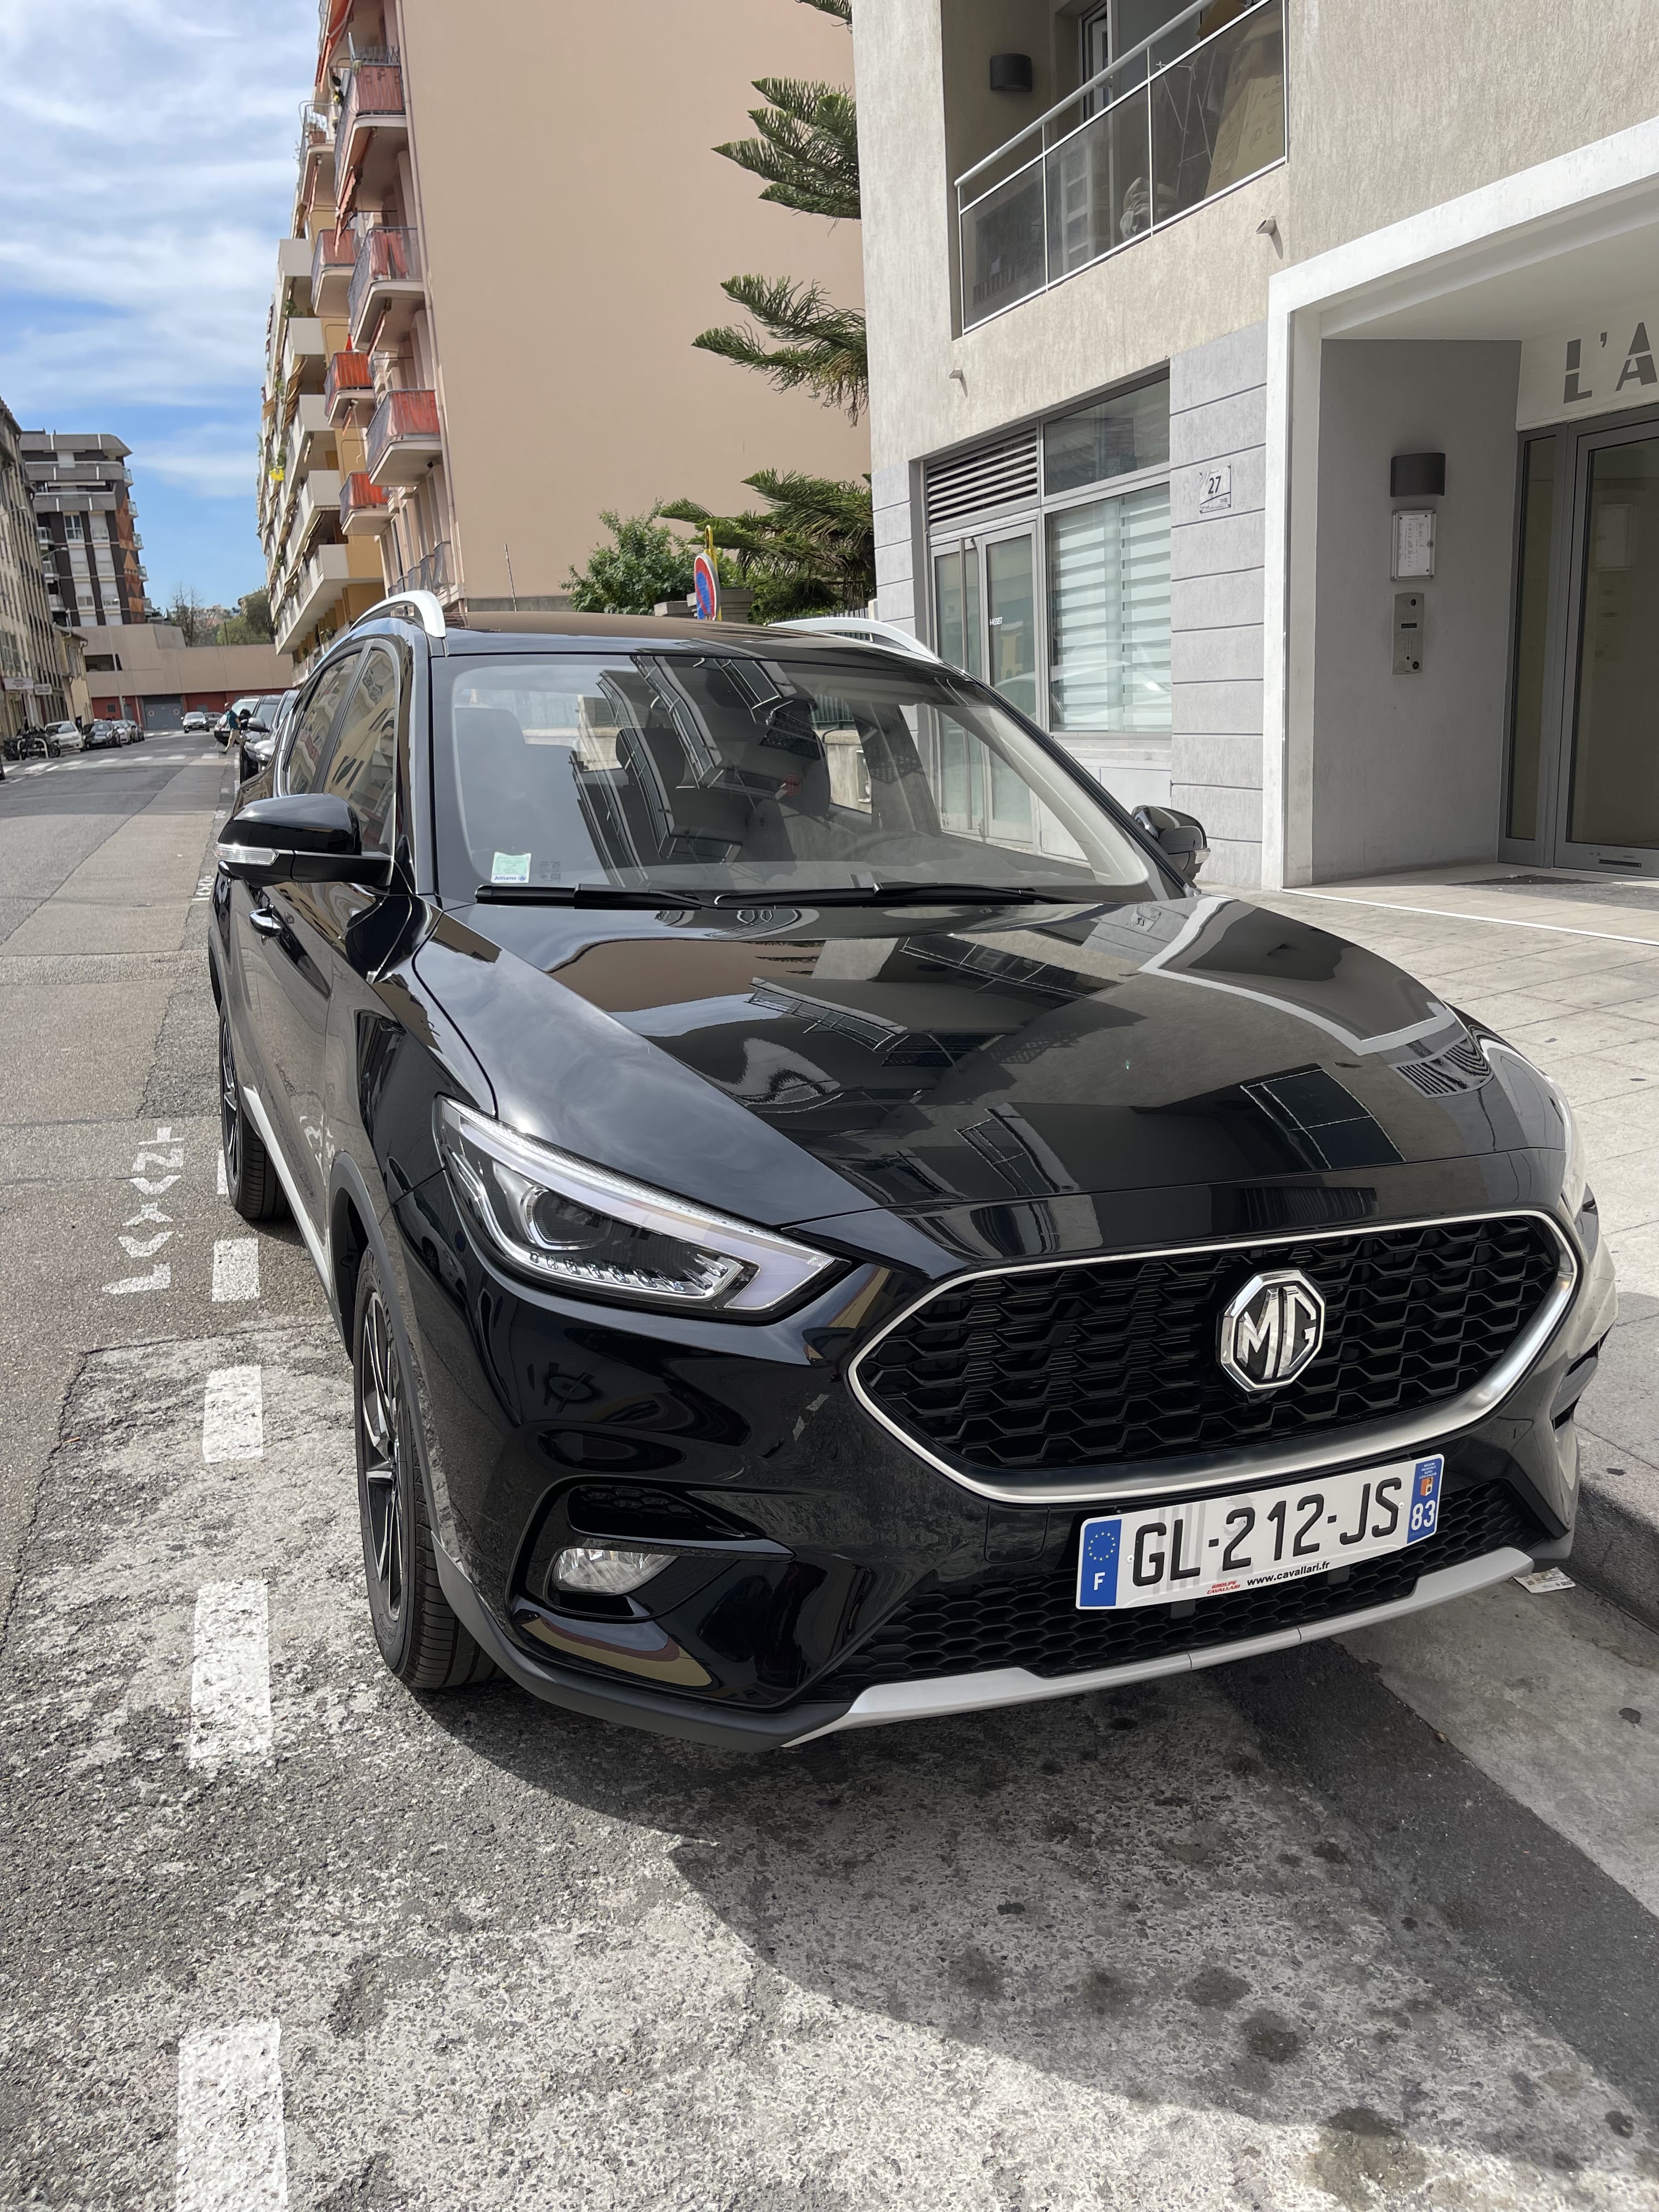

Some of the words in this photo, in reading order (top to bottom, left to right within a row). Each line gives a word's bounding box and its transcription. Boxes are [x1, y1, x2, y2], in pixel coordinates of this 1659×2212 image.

[1208, 476, 1221, 494] 27
[1236, 1285, 1317, 1380] MG
[1411, 1500, 1436, 1531] 83
[1132, 1477, 1402, 1587] GL-212-JS
[1093, 1572, 1105, 1590] F
[1246, 1561, 1330, 1586] www.cavallari.fr
[1206, 1584, 1241, 1595] CAVALLARI
[1211, 1580, 1238, 1589] GROUPE
